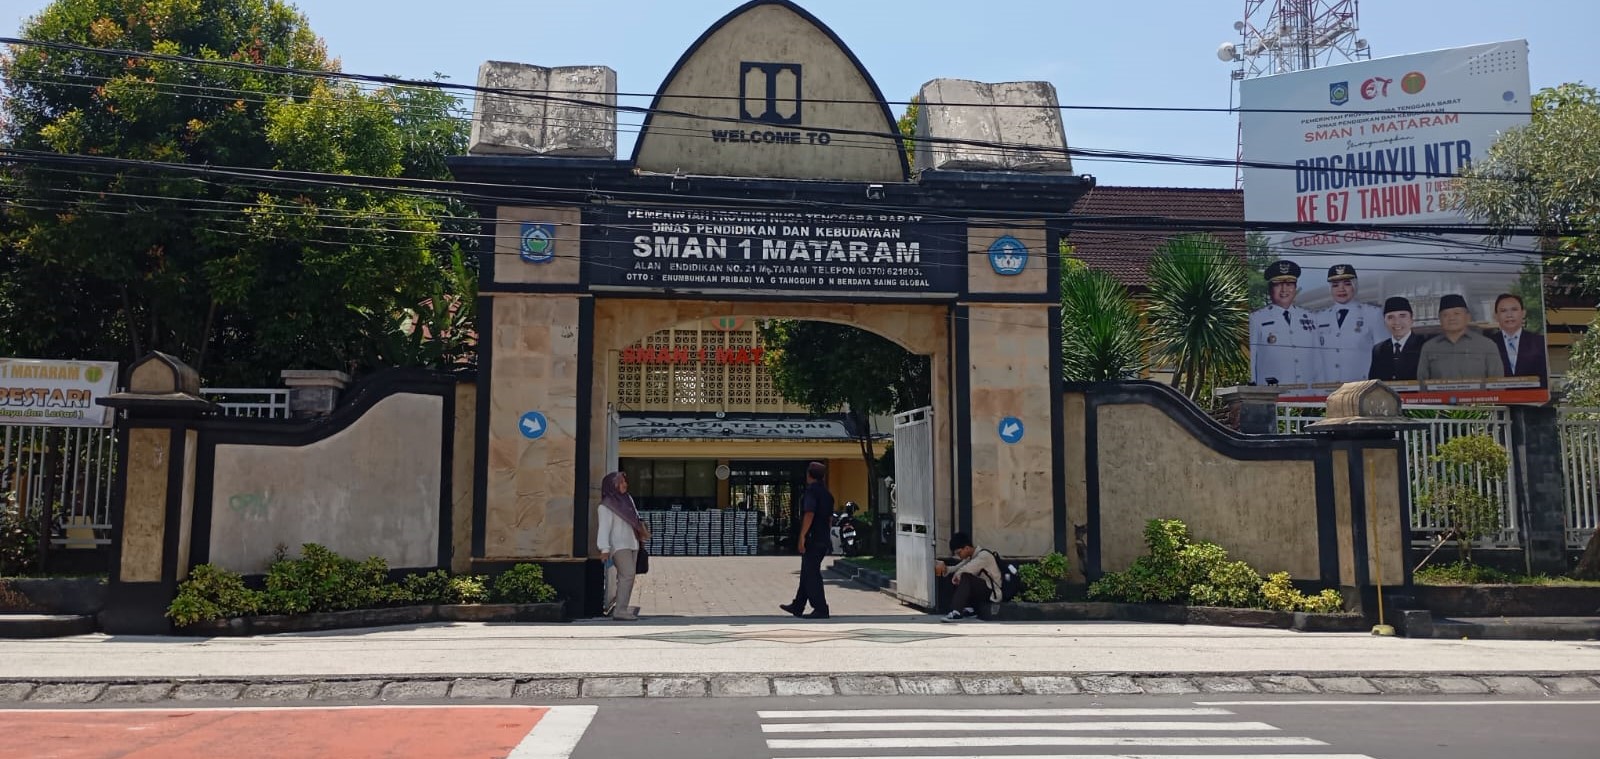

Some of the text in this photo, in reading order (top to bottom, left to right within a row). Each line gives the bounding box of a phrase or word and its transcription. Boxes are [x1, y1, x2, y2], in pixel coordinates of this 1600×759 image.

[1344, 111, 1377, 119] PROVI
[1397, 108, 1445, 118] KEBUAAN
[1304, 113, 1459, 143] SMAN 1 MATARAM
[711, 129, 831, 146] WELCOME TO
[1295, 145, 1416, 194] DIRGAHAYU
[1296, 183, 1421, 224] KE 67 TAHUN
[652, 222, 901, 239] DINAS PENDIDIKAN DAN KEBUDAYAAN
[632, 235, 920, 264] SMAN 1 MATARAM
[726, 264, 743, 273] NO.
[745, 265, 757, 273] 21
[812, 266, 856, 275] TELEPON
[720, 275, 752, 283] PRIBADI
[779, 277, 816, 285] TANGGUH
[837, 278, 871, 286] BERDAYA
[874, 278, 897, 286] SAING
[900, 278, 930, 287] GLOBAL
[622, 346, 689, 365] SMAN
[715, 346, 764, 366] MAT
[1, 363, 81, 380] 1 MATARAM
[0, 386, 92, 409] BESTARI
[0, 408, 22, 419] daya
